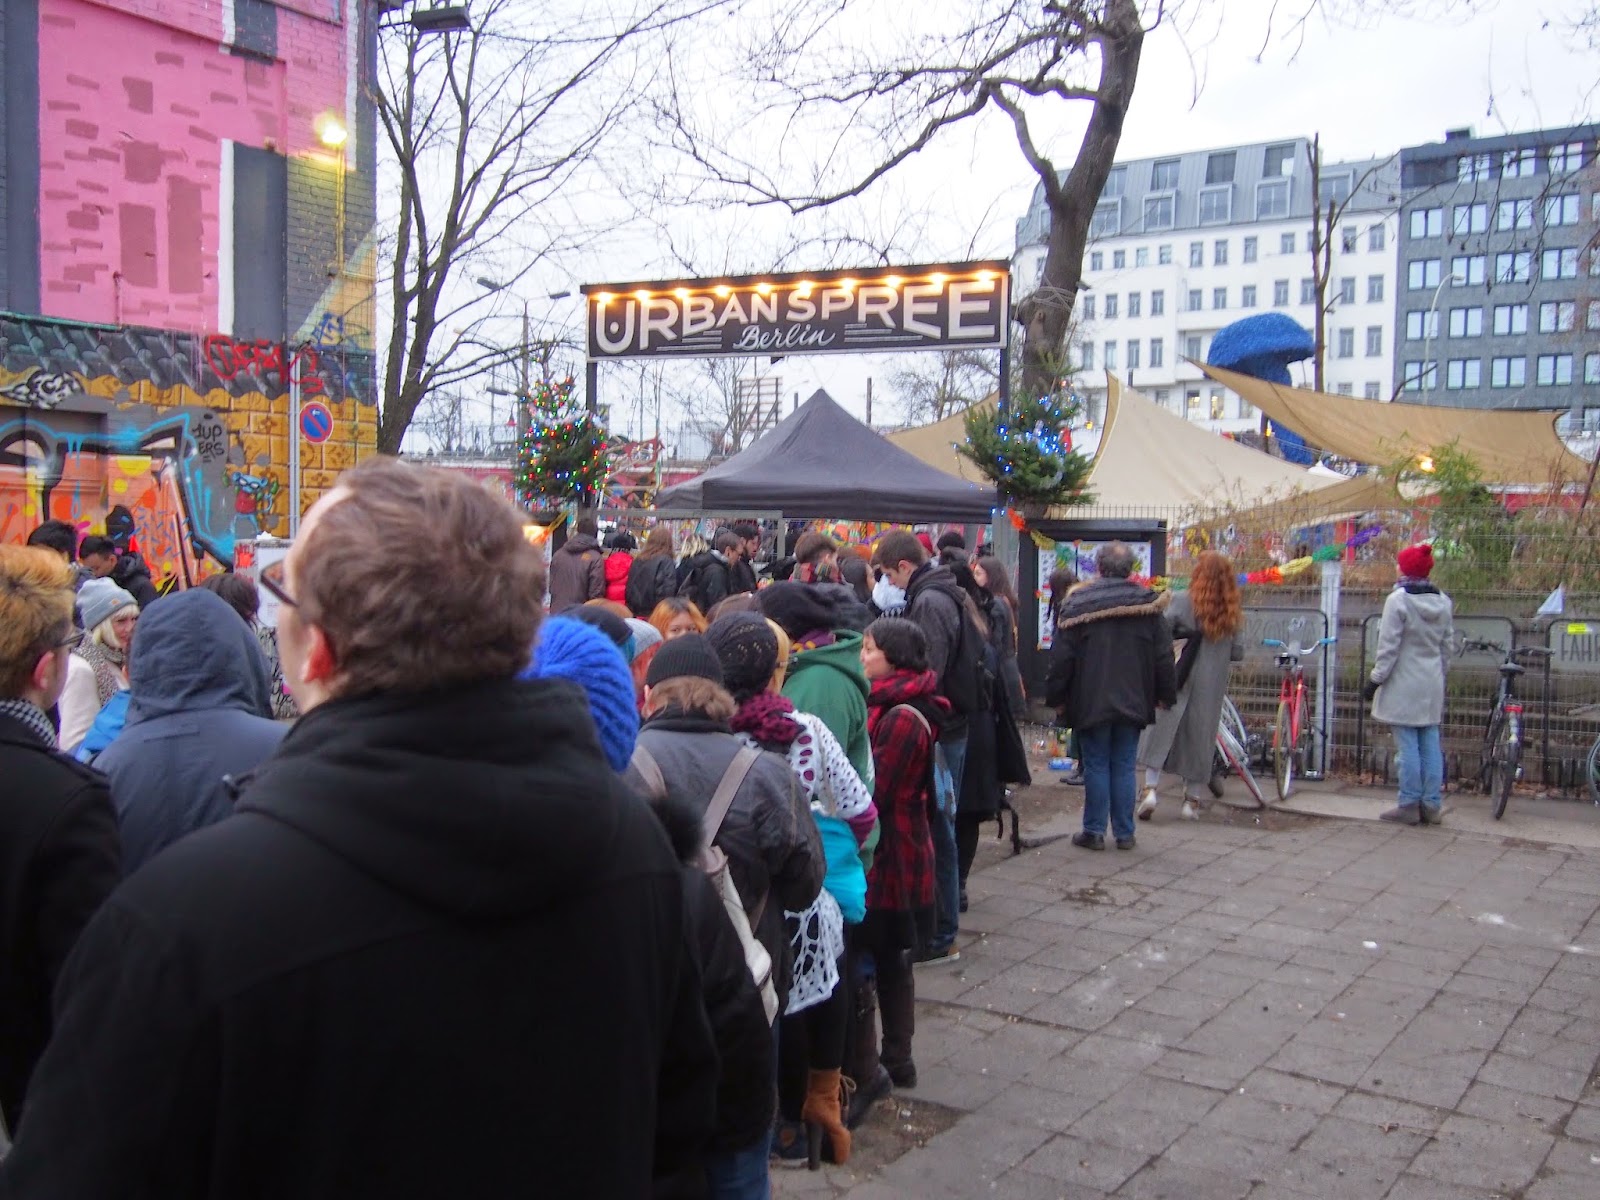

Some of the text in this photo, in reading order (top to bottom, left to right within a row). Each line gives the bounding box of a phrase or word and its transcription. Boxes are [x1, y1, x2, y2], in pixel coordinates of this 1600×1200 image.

[596, 279, 996, 354] URBAN SPREE
[733, 323, 836, 351] Berlin
